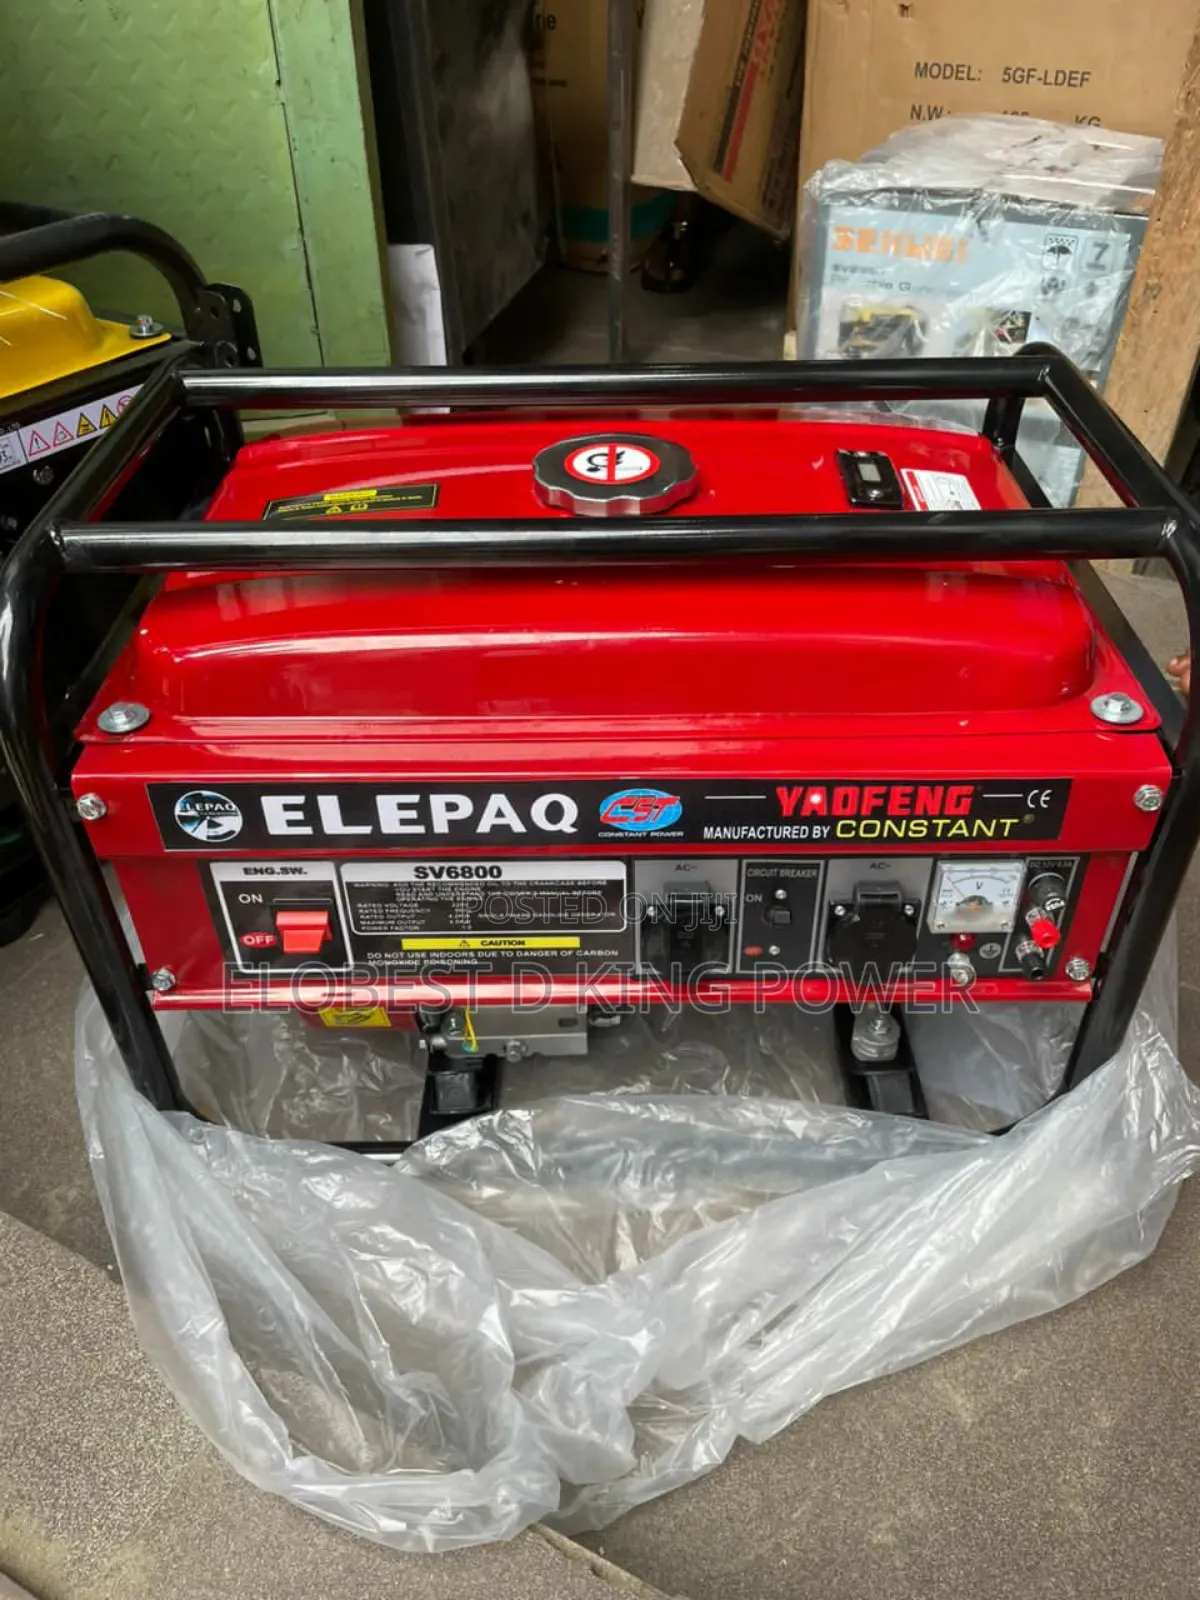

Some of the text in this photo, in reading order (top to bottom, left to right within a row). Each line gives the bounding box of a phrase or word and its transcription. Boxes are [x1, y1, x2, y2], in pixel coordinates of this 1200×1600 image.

[915, 62, 1091, 88] MODEL: 5GF-LDEF
[775, 785, 975, 817] YAOFENG
[260, 793, 578, 836] ELEPAQ
[600, 795, 681, 824] CST
[703, 818, 1019, 840] MANUFACTURED BY CONSTANT
[413, 865, 503, 880] SV6800
[747, 868, 816, 878] CIRCUIT BREAKER
[238, 893, 263, 904] ON
[746, 894, 763, 902] ON
[242, 934, 275, 946] OFF
[480, 939, 526, 947] CAUTION
[407, 951, 427, 959] USE
[559, 949, 574, 957] OF
[576, 949, 619, 957] CARBON
[368, 959, 479, 967] MONOXIDE POISONING
